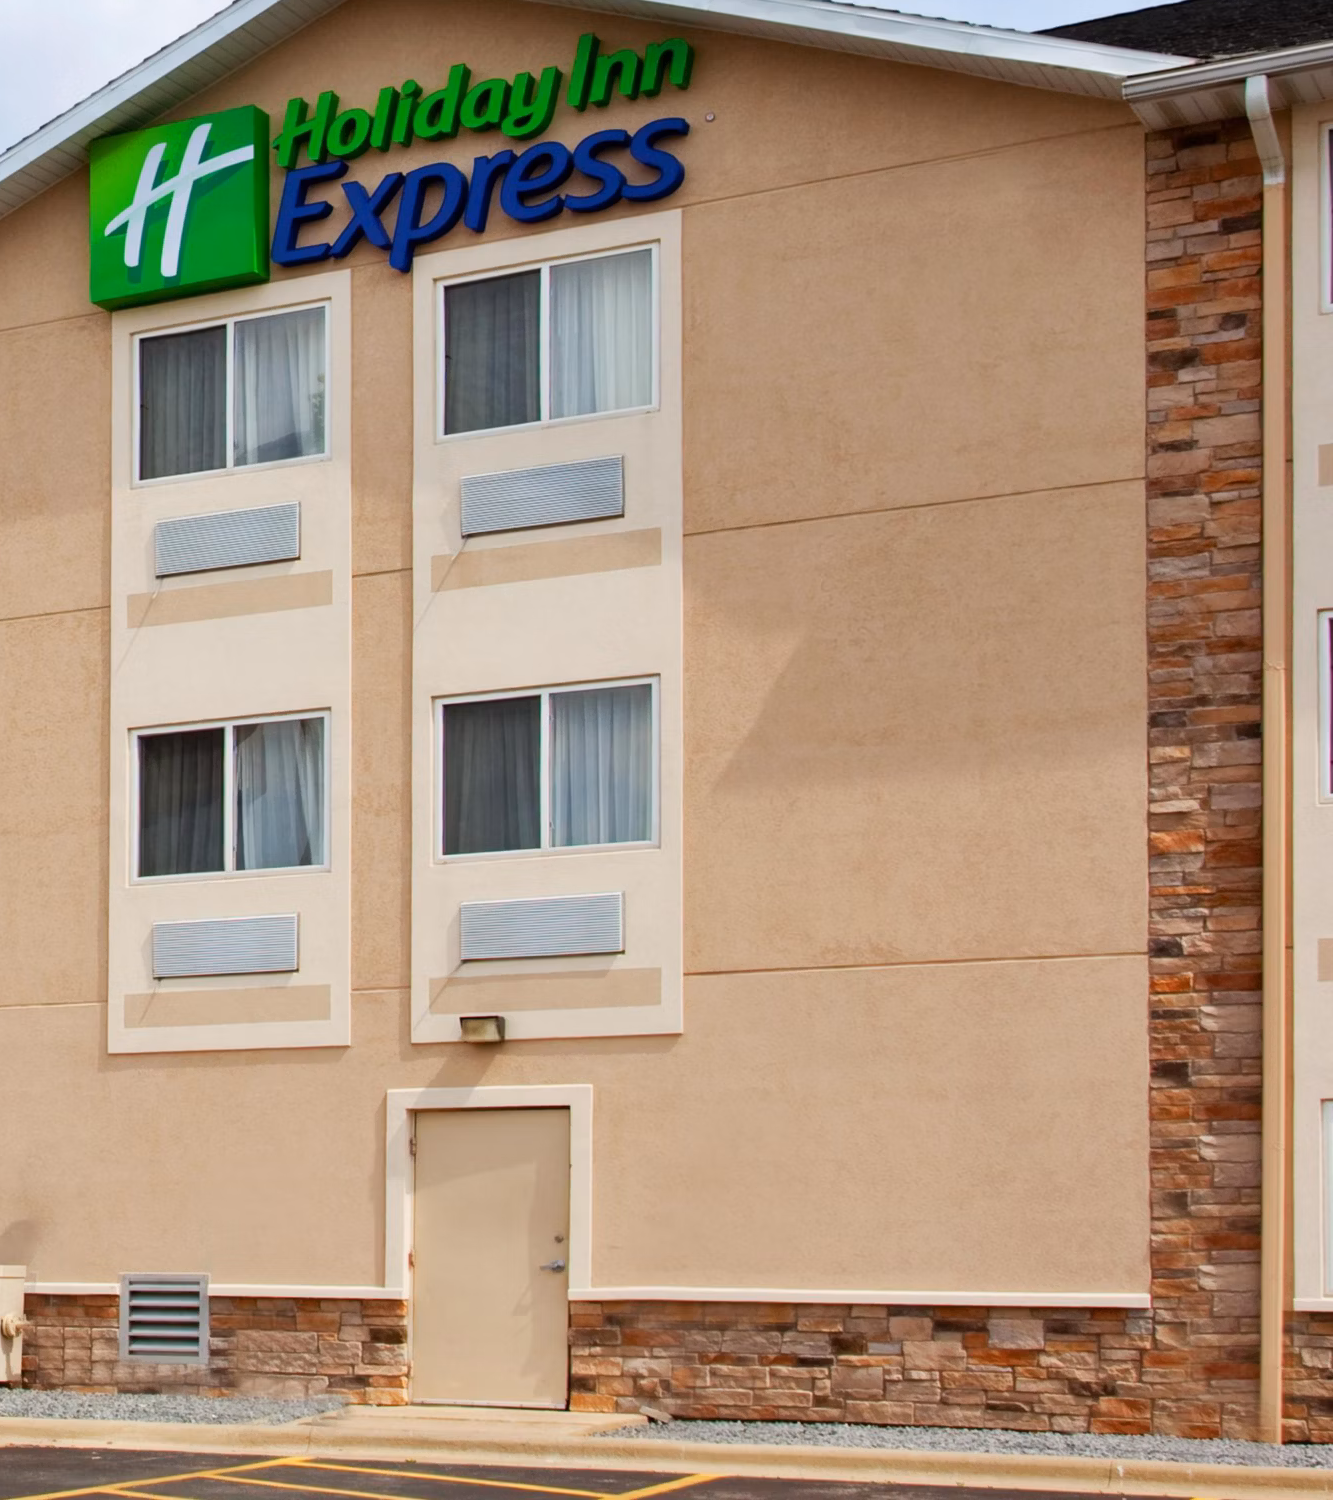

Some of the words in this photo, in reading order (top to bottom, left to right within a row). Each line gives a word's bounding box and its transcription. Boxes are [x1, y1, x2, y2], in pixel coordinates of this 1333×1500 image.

[272, 63, 563, 170] Holiday
[565, 33, 694, 113] Inn
[270, 117, 690, 274] Express
